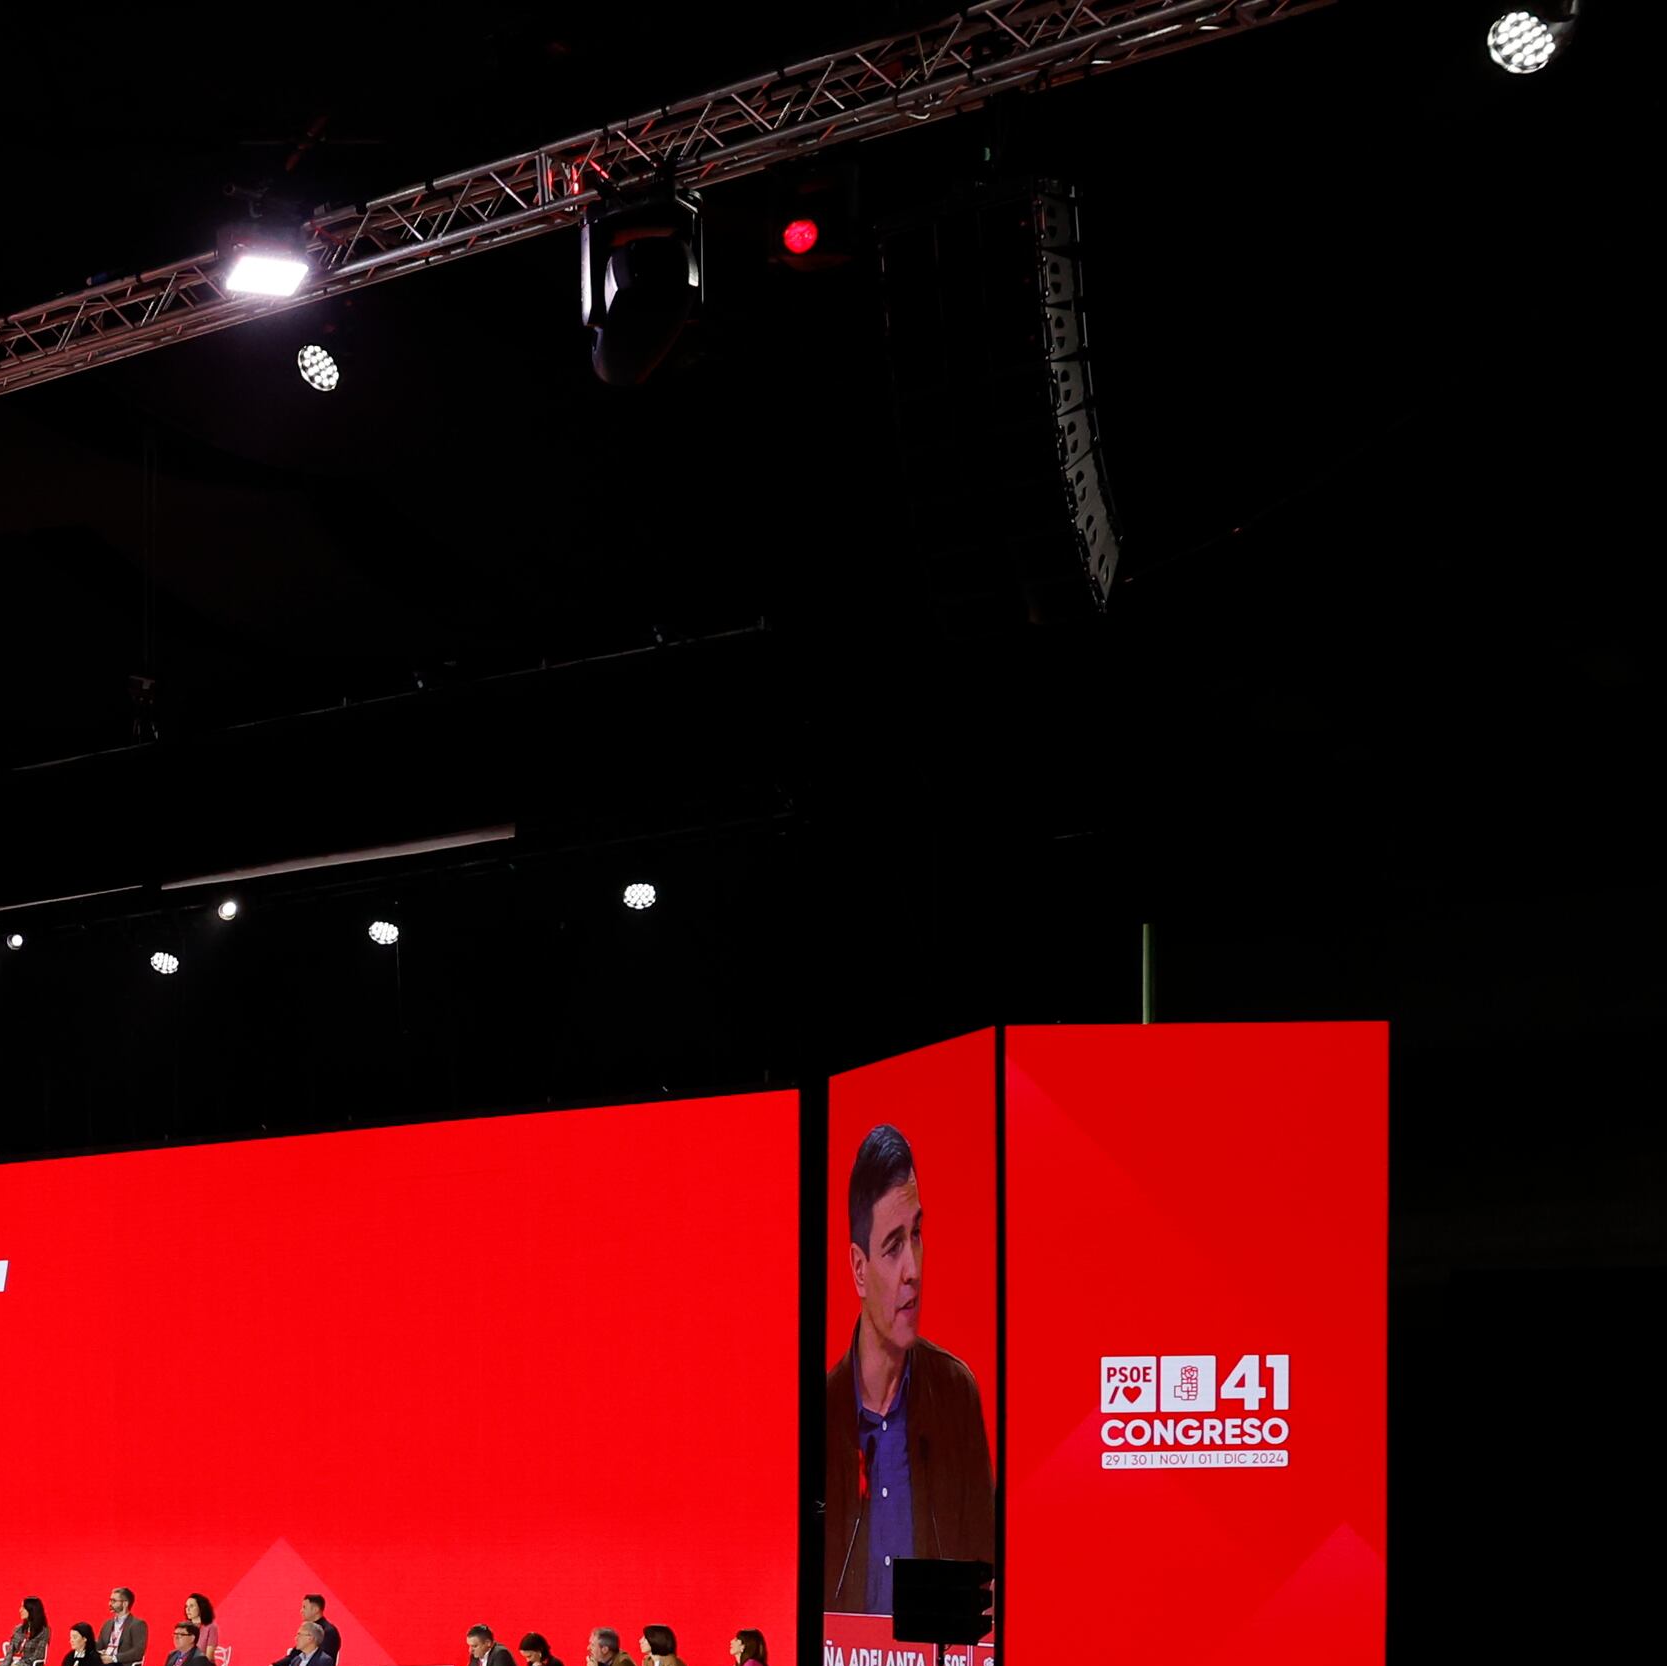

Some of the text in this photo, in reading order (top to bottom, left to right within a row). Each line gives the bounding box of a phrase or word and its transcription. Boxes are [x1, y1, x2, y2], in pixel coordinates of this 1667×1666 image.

[1107, 1366, 1152, 1383] PSOE
[1220, 1354, 1289, 1411] 41
[1100, 1417, 1289, 1447] CONGRESO
[1105, 1453, 1284, 1466] 29 30 NOV 01 DIC 2024
